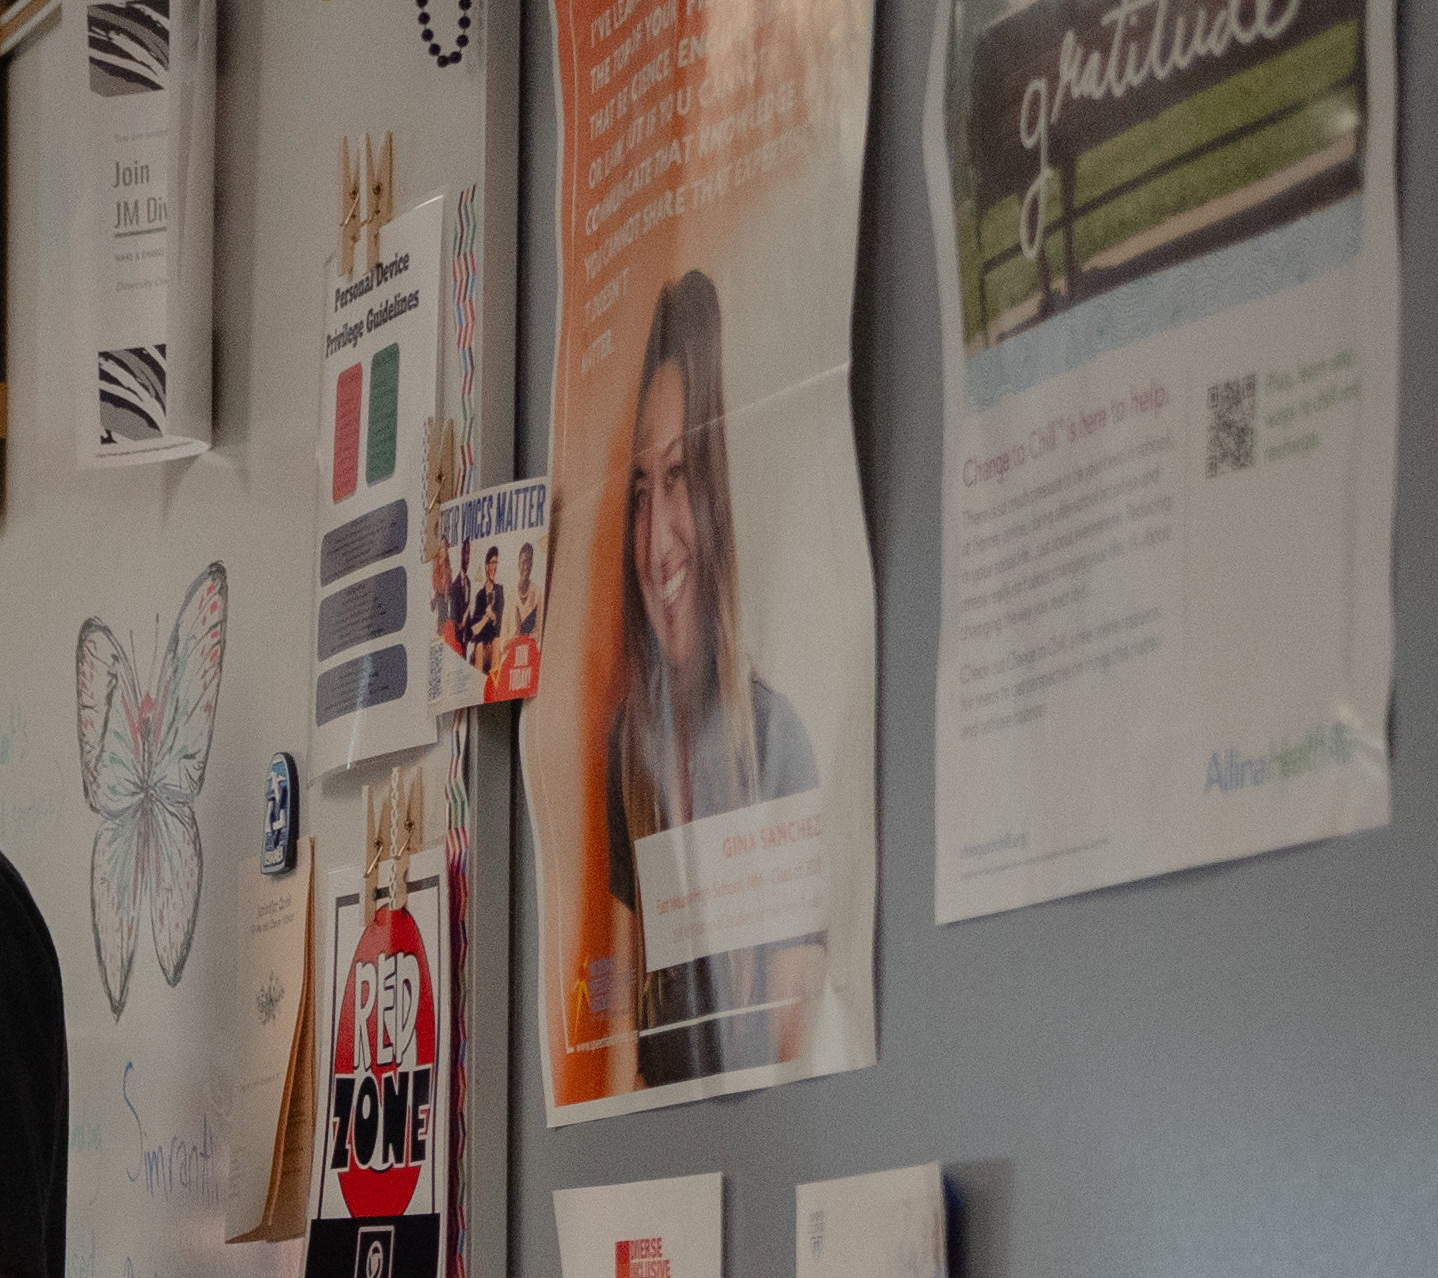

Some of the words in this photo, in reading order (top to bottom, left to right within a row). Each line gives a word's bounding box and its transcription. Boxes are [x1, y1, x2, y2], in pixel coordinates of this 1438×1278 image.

[589, 58, 610, 94] THE
[631, 53, 671, 103] CIENCE
[1018, 0, 1301, 261] gratitude
[112, 160, 150, 189] Join
[113, 198, 140, 230] JM
[334, 267, 374, 313] Personal
[376, 252, 410, 287] Device
[325, 319, 364, 359] Privilege
[366, 288, 419, 334] Guidelines
[962, 449, 1012, 487] Change
[1012, 442, 1026, 467] to
[1078, 405, 1109, 438] here
[1111, 398, 1126, 423] to
[461, 493, 494, 543] VOICES
[494, 482, 547, 536] MATTER
[722, 831, 756, 859] GINA
[760, 813, 823, 850] SANCHEZ
[353, 951, 422, 1072] RED
[330, 1067, 432, 1170] ZONE
[630, 1236, 663, 1259] DIVERSE
